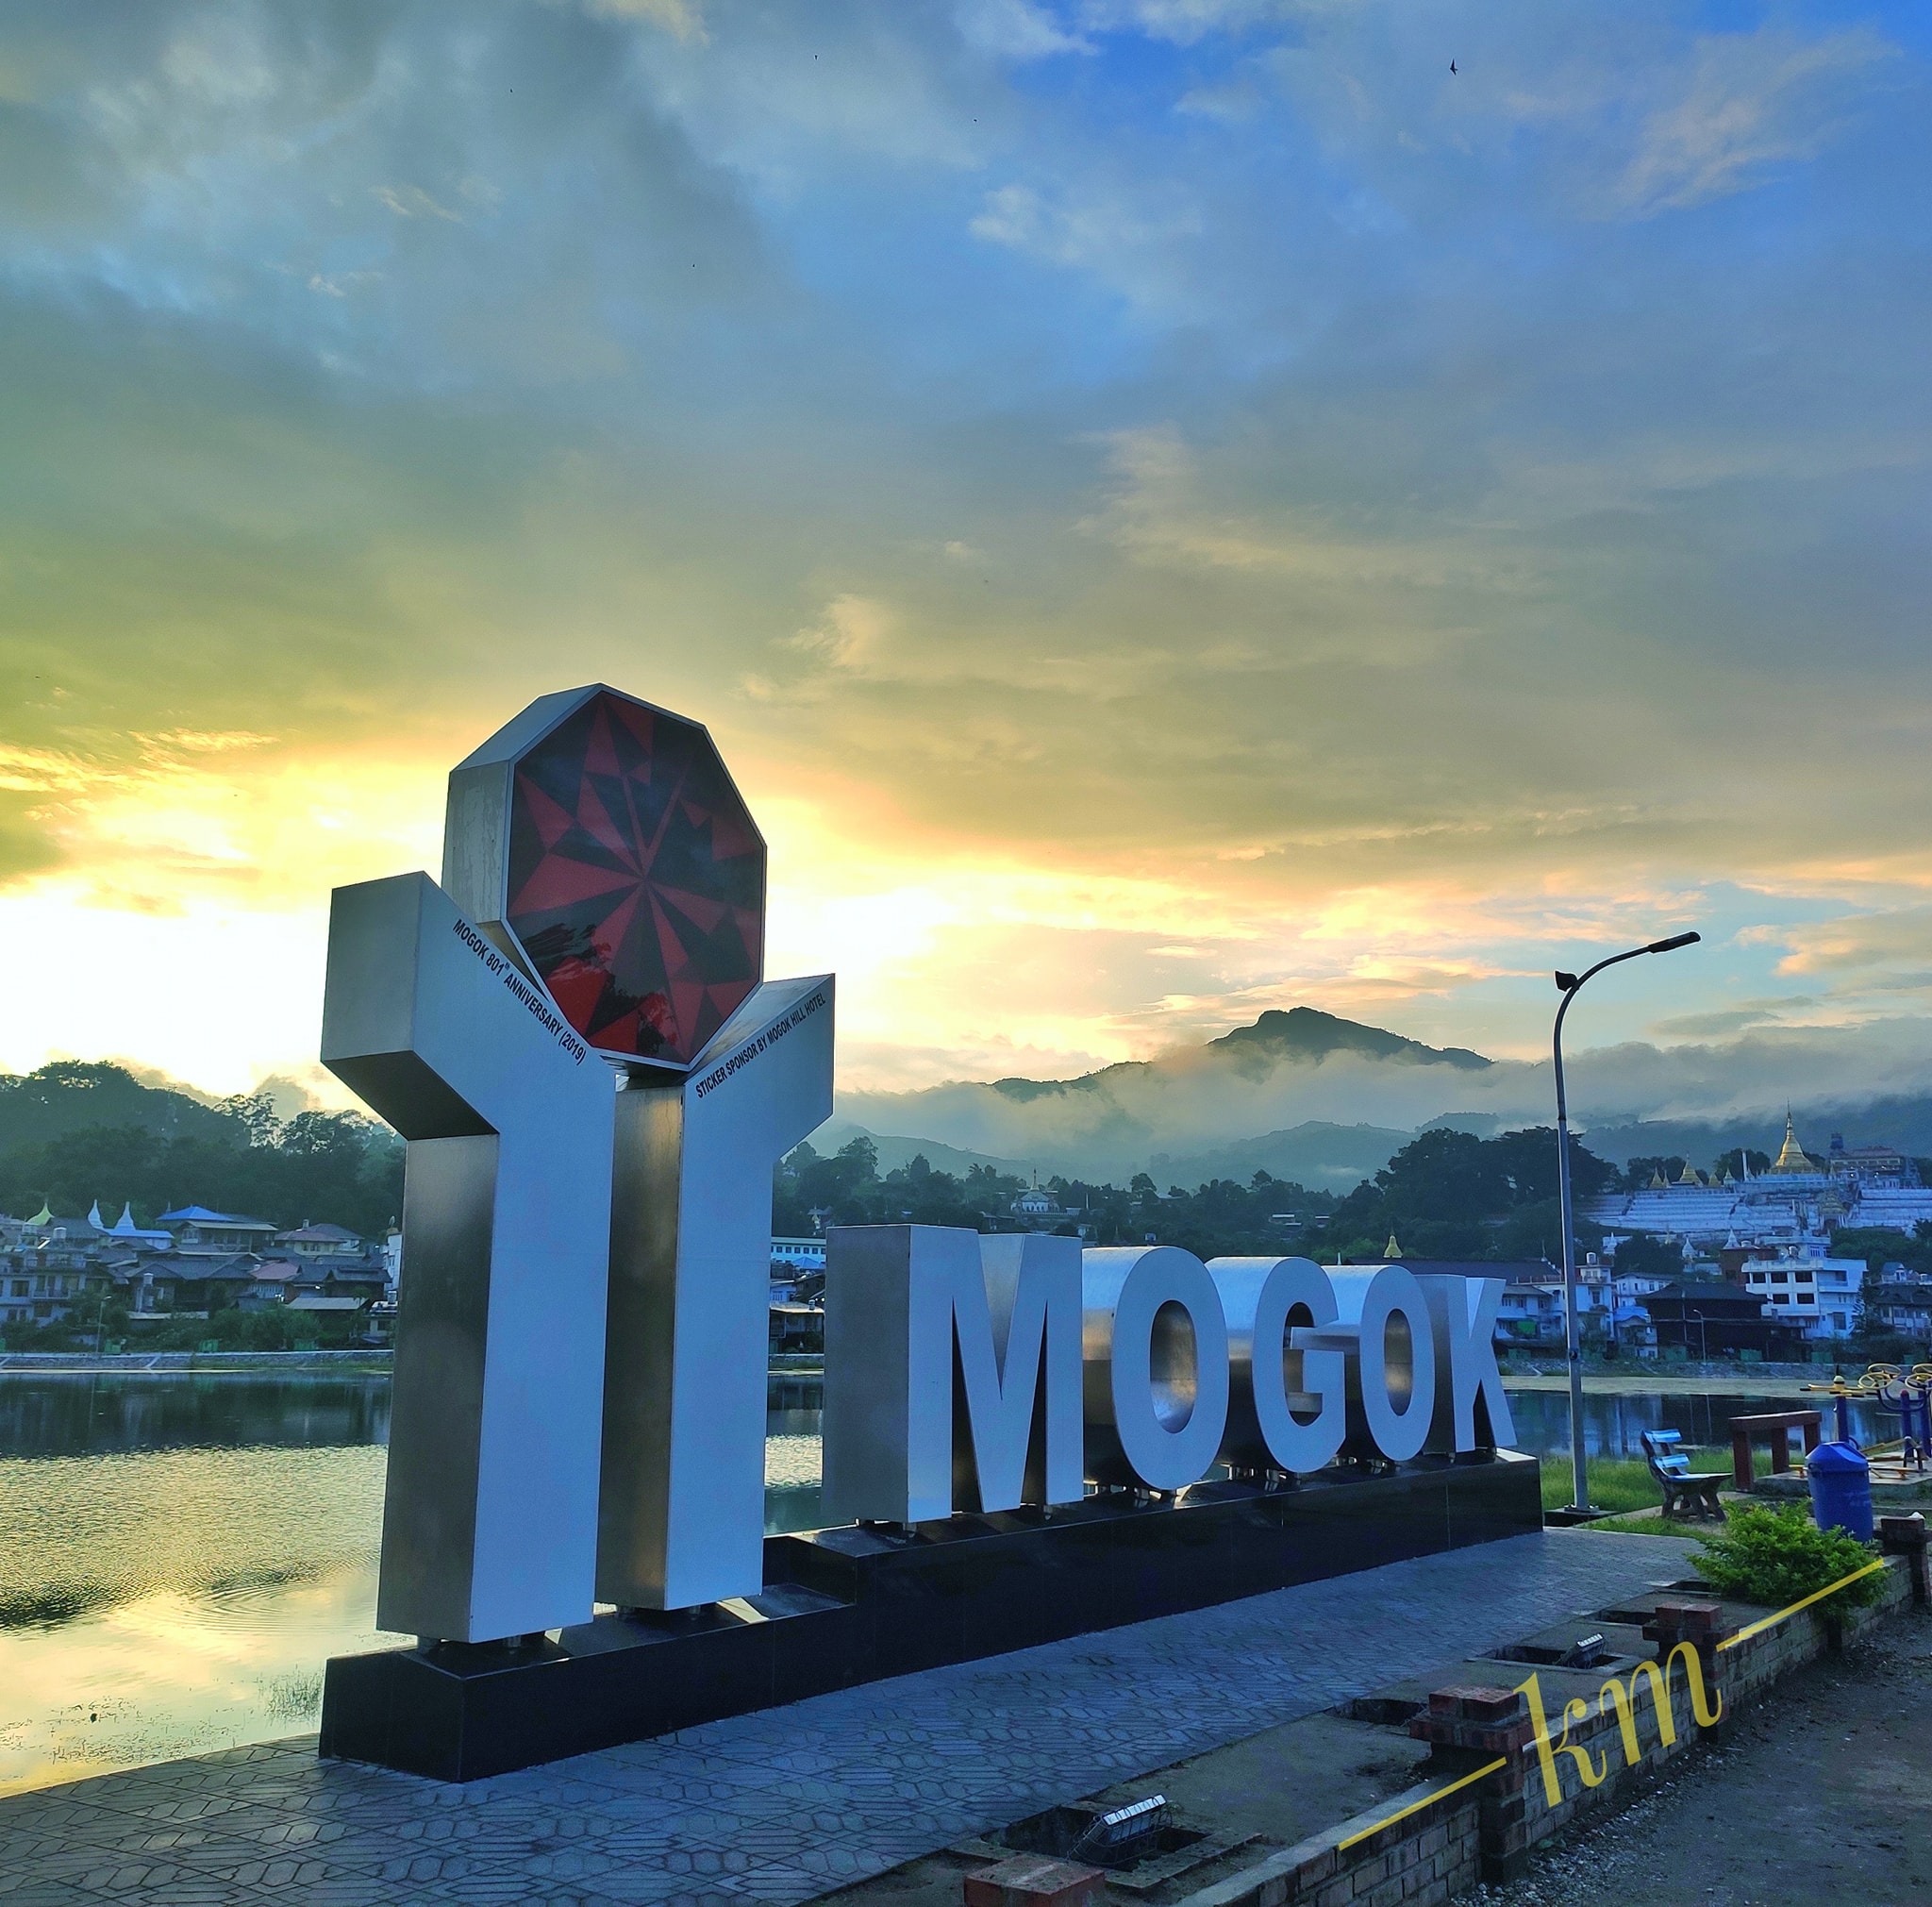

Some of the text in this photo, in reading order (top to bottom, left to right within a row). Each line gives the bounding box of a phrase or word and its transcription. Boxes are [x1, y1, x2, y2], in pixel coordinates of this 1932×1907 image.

[453, 919, 489, 961] MOGOK
[504, 973, 563, 1037] ANNIVERSARY
[558, 1030, 587, 1065] (2019)
[695, 993, 826, 1098] STICKER SPONSOR BY MOGOK HILL HOTEL
[908, 1226, 1518, 1521] MOGOK
